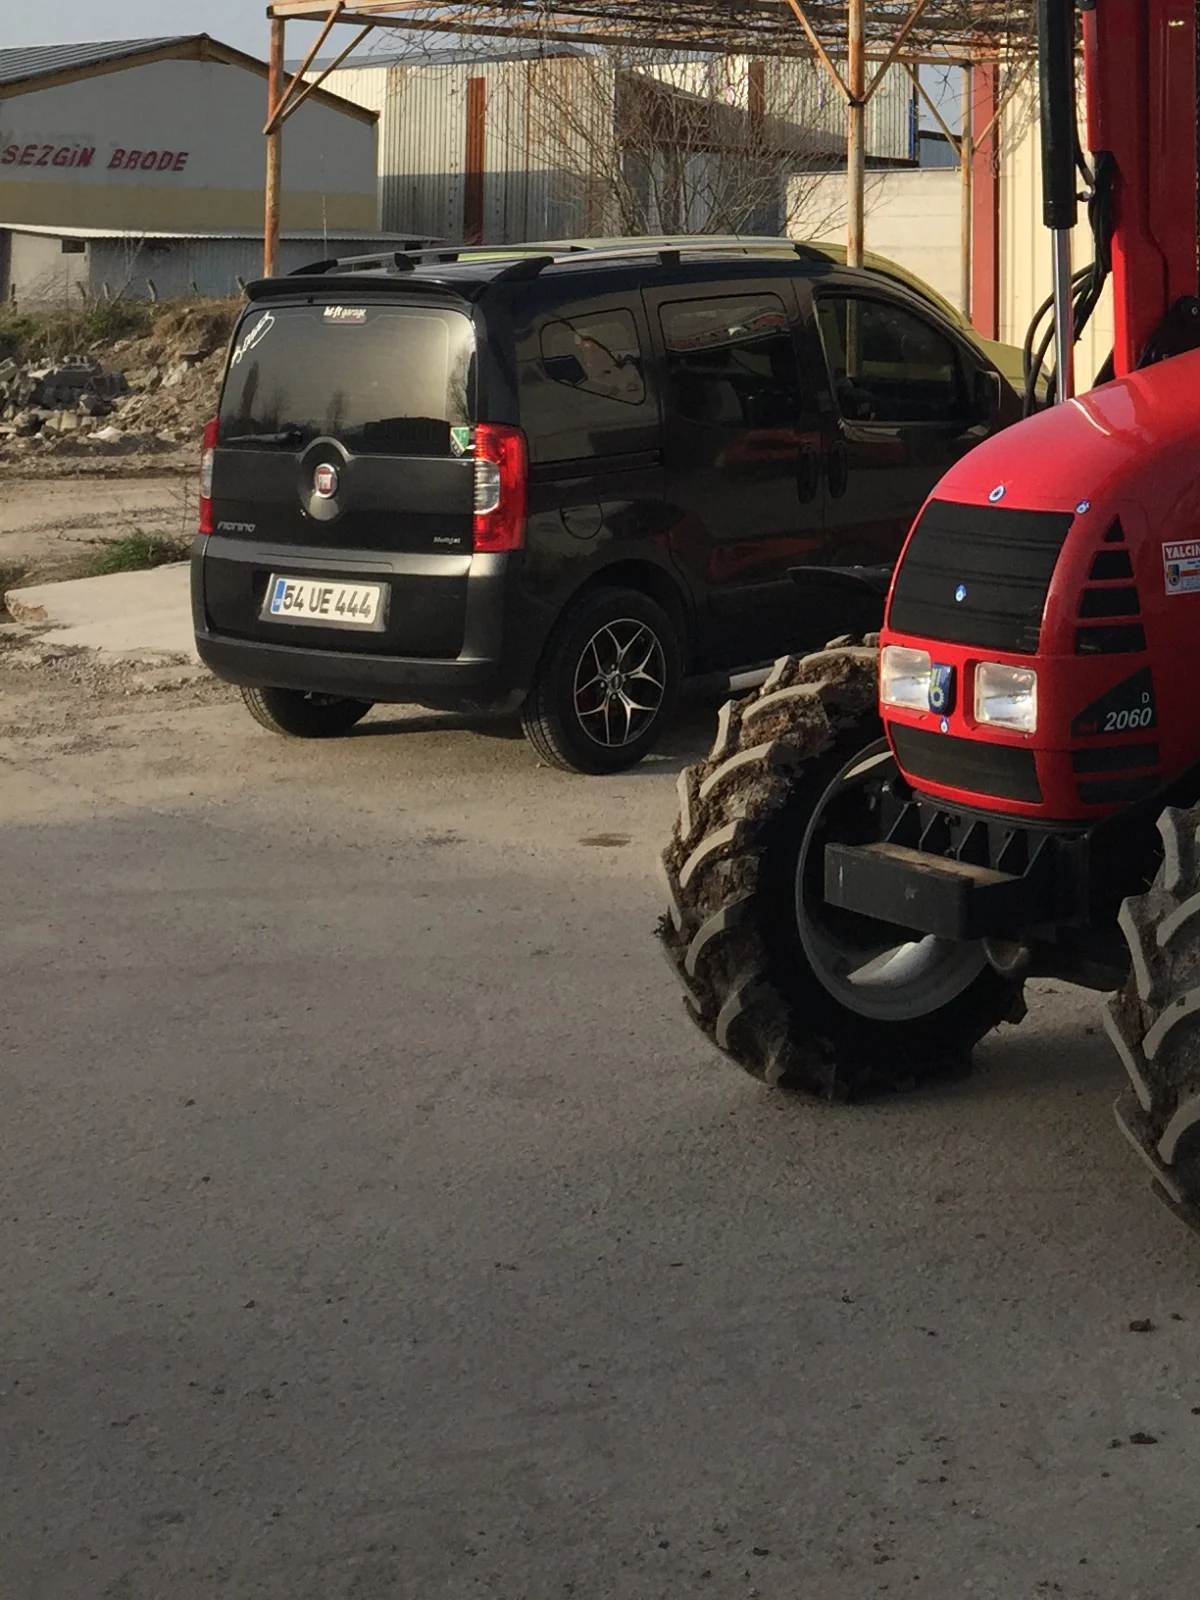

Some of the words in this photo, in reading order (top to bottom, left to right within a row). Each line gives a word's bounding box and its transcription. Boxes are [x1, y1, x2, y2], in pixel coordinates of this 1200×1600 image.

[107, 148, 189, 171] BRODE
[284, 585, 304, 611] 54
[309, 587, 333, 613] UE
[334, 590, 371, 618] 444
[1142, 692, 1149, 704] D
[1104, 707, 1152, 731] 2060
